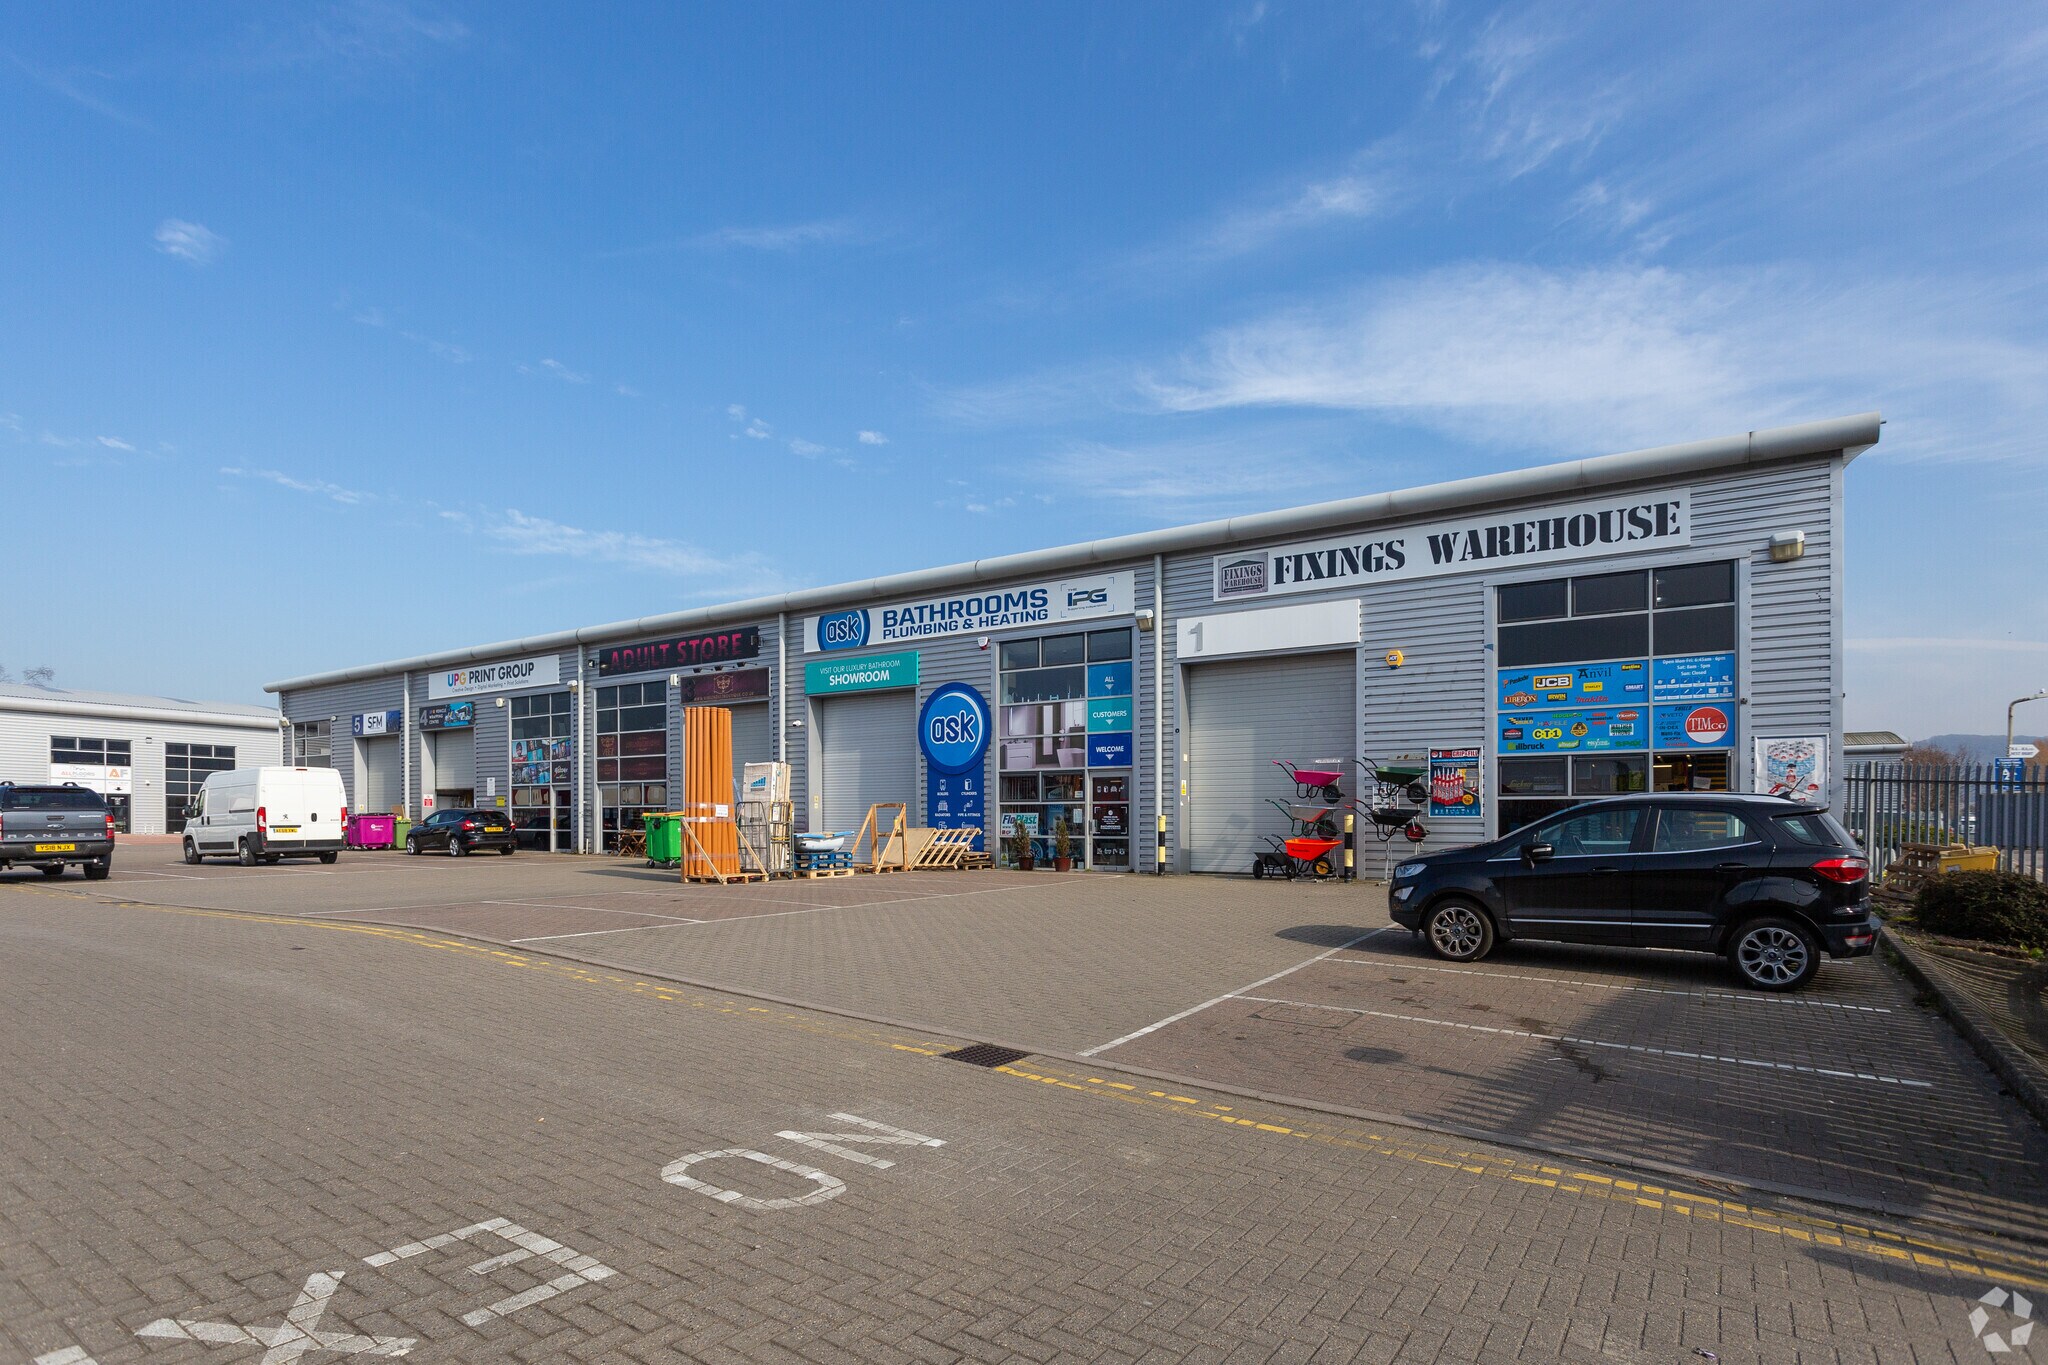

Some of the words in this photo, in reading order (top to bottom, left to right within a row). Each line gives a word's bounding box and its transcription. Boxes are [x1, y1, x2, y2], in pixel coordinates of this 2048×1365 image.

[1274, 539, 1405, 585] FIXINGS
[1427, 501, 1680, 565] WAREHOUSE
[1224, 565, 1262, 580] FIXINGS
[1224, 577, 1262, 588] WAREHOUSE
[883, 588, 1048, 628] BATHROOMS
[826, 615, 859, 643] ask
[883, 620, 958, 639] PLUMBING
[962, 618, 974, 629] &
[978, 608, 1048, 628] HEATING
[1189, 622, 1203, 652] 1
[610, 644, 670, 670] ADULT
[677, 633, 742, 663] STORE
[833, 665, 845, 673] OUR
[846, 663, 867, 672] LUXURY
[868, 660, 900, 669] BATHROOM
[1576, 667, 1611, 679] Anvil
[448, 671, 466, 687] UPG
[469, 668, 495, 684] PRINT
[498, 662, 534, 680] GROUP
[829, 670, 890, 686] SHOWROOM
[1536, 677, 1570, 687] JCB
[1504, 694, 1537, 703] LIBERON
[420, 709, 428, 726] 4
[1092, 710, 1127, 718] CUSTOMERS
[354, 717, 360, 732] 5
[367, 715, 383, 729] SFM
[931, 710, 975, 744] ask
[1095, 745, 1124, 753] WELCOME
